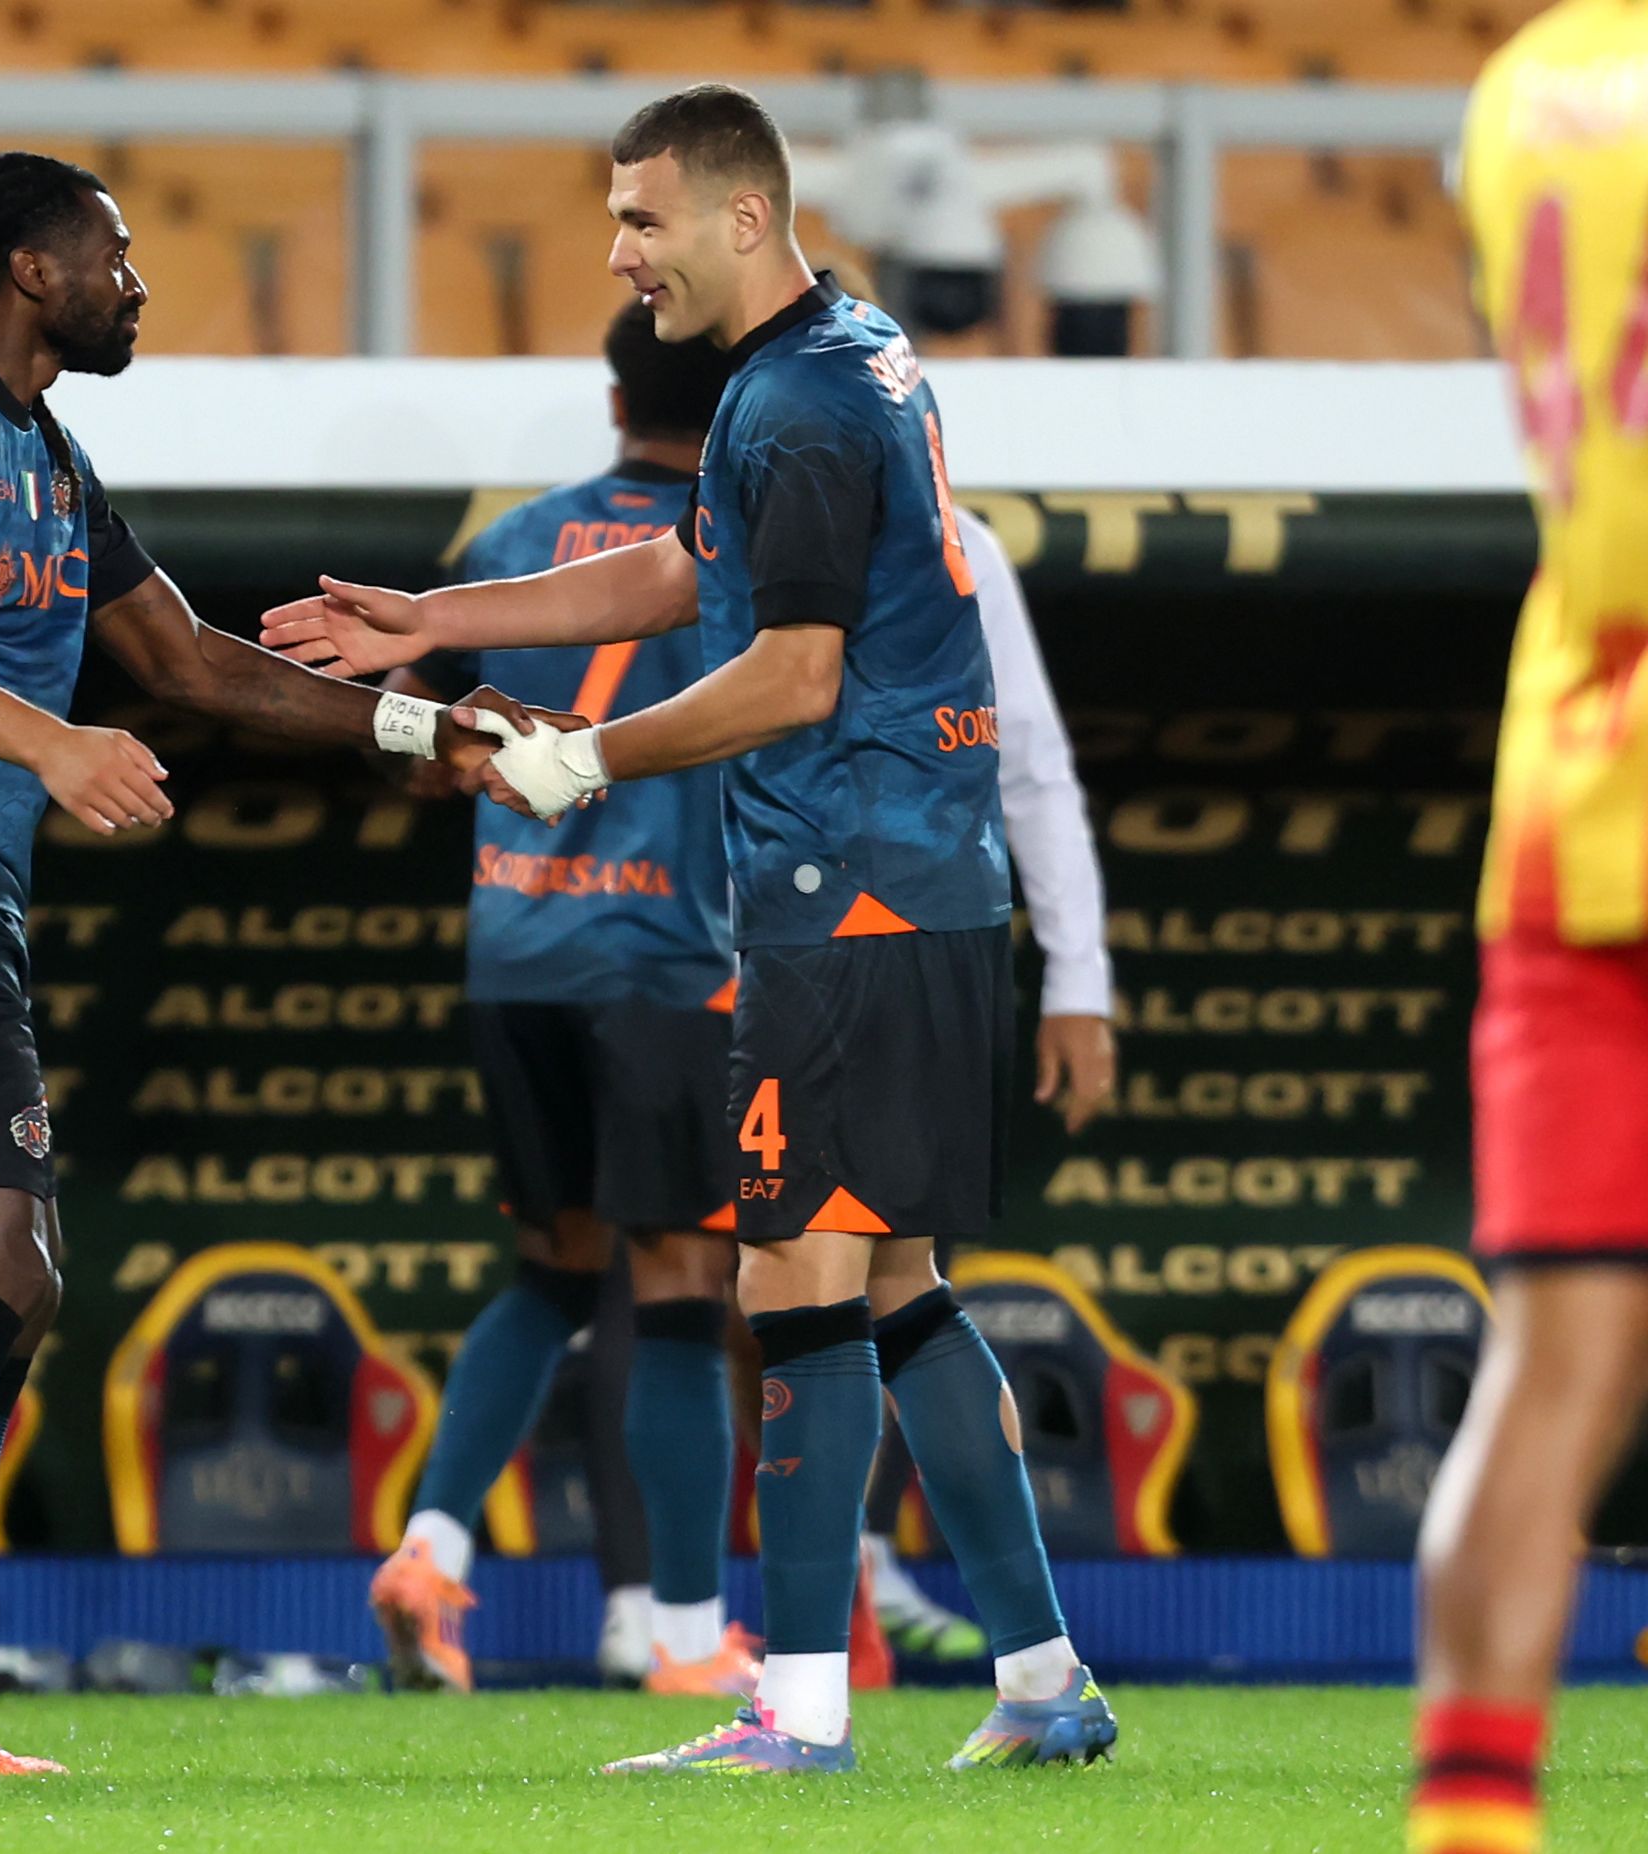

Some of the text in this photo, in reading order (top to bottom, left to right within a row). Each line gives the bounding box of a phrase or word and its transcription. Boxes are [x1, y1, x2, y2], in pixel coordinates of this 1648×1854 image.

[1058, 1071, 1431, 1118] LCOTT
[738, 1078, 788, 1171] 4
[120, 1154, 498, 1203] ALCOTT
[740, 1178, 785, 1200] EA7
[1044, 1157, 1421, 1207] ALCOTT
